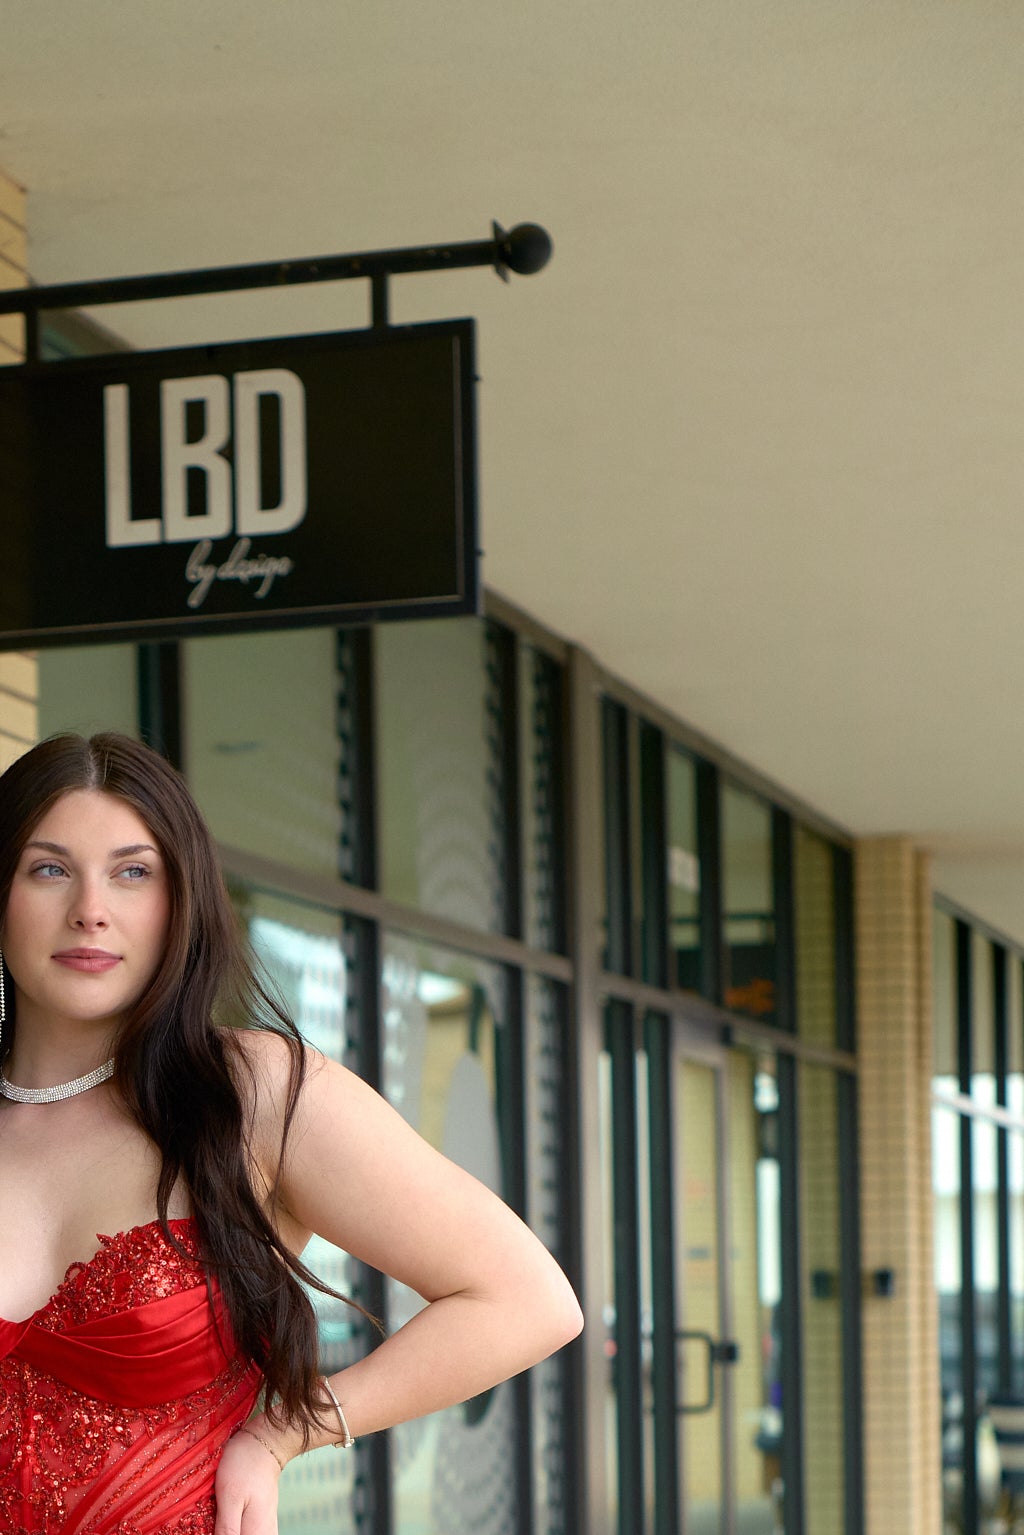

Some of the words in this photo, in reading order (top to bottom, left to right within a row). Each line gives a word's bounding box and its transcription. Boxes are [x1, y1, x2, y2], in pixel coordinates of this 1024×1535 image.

[103, 368, 308, 548] LBD
[185, 538, 217, 608] by
[216, 537, 293, 599] design
